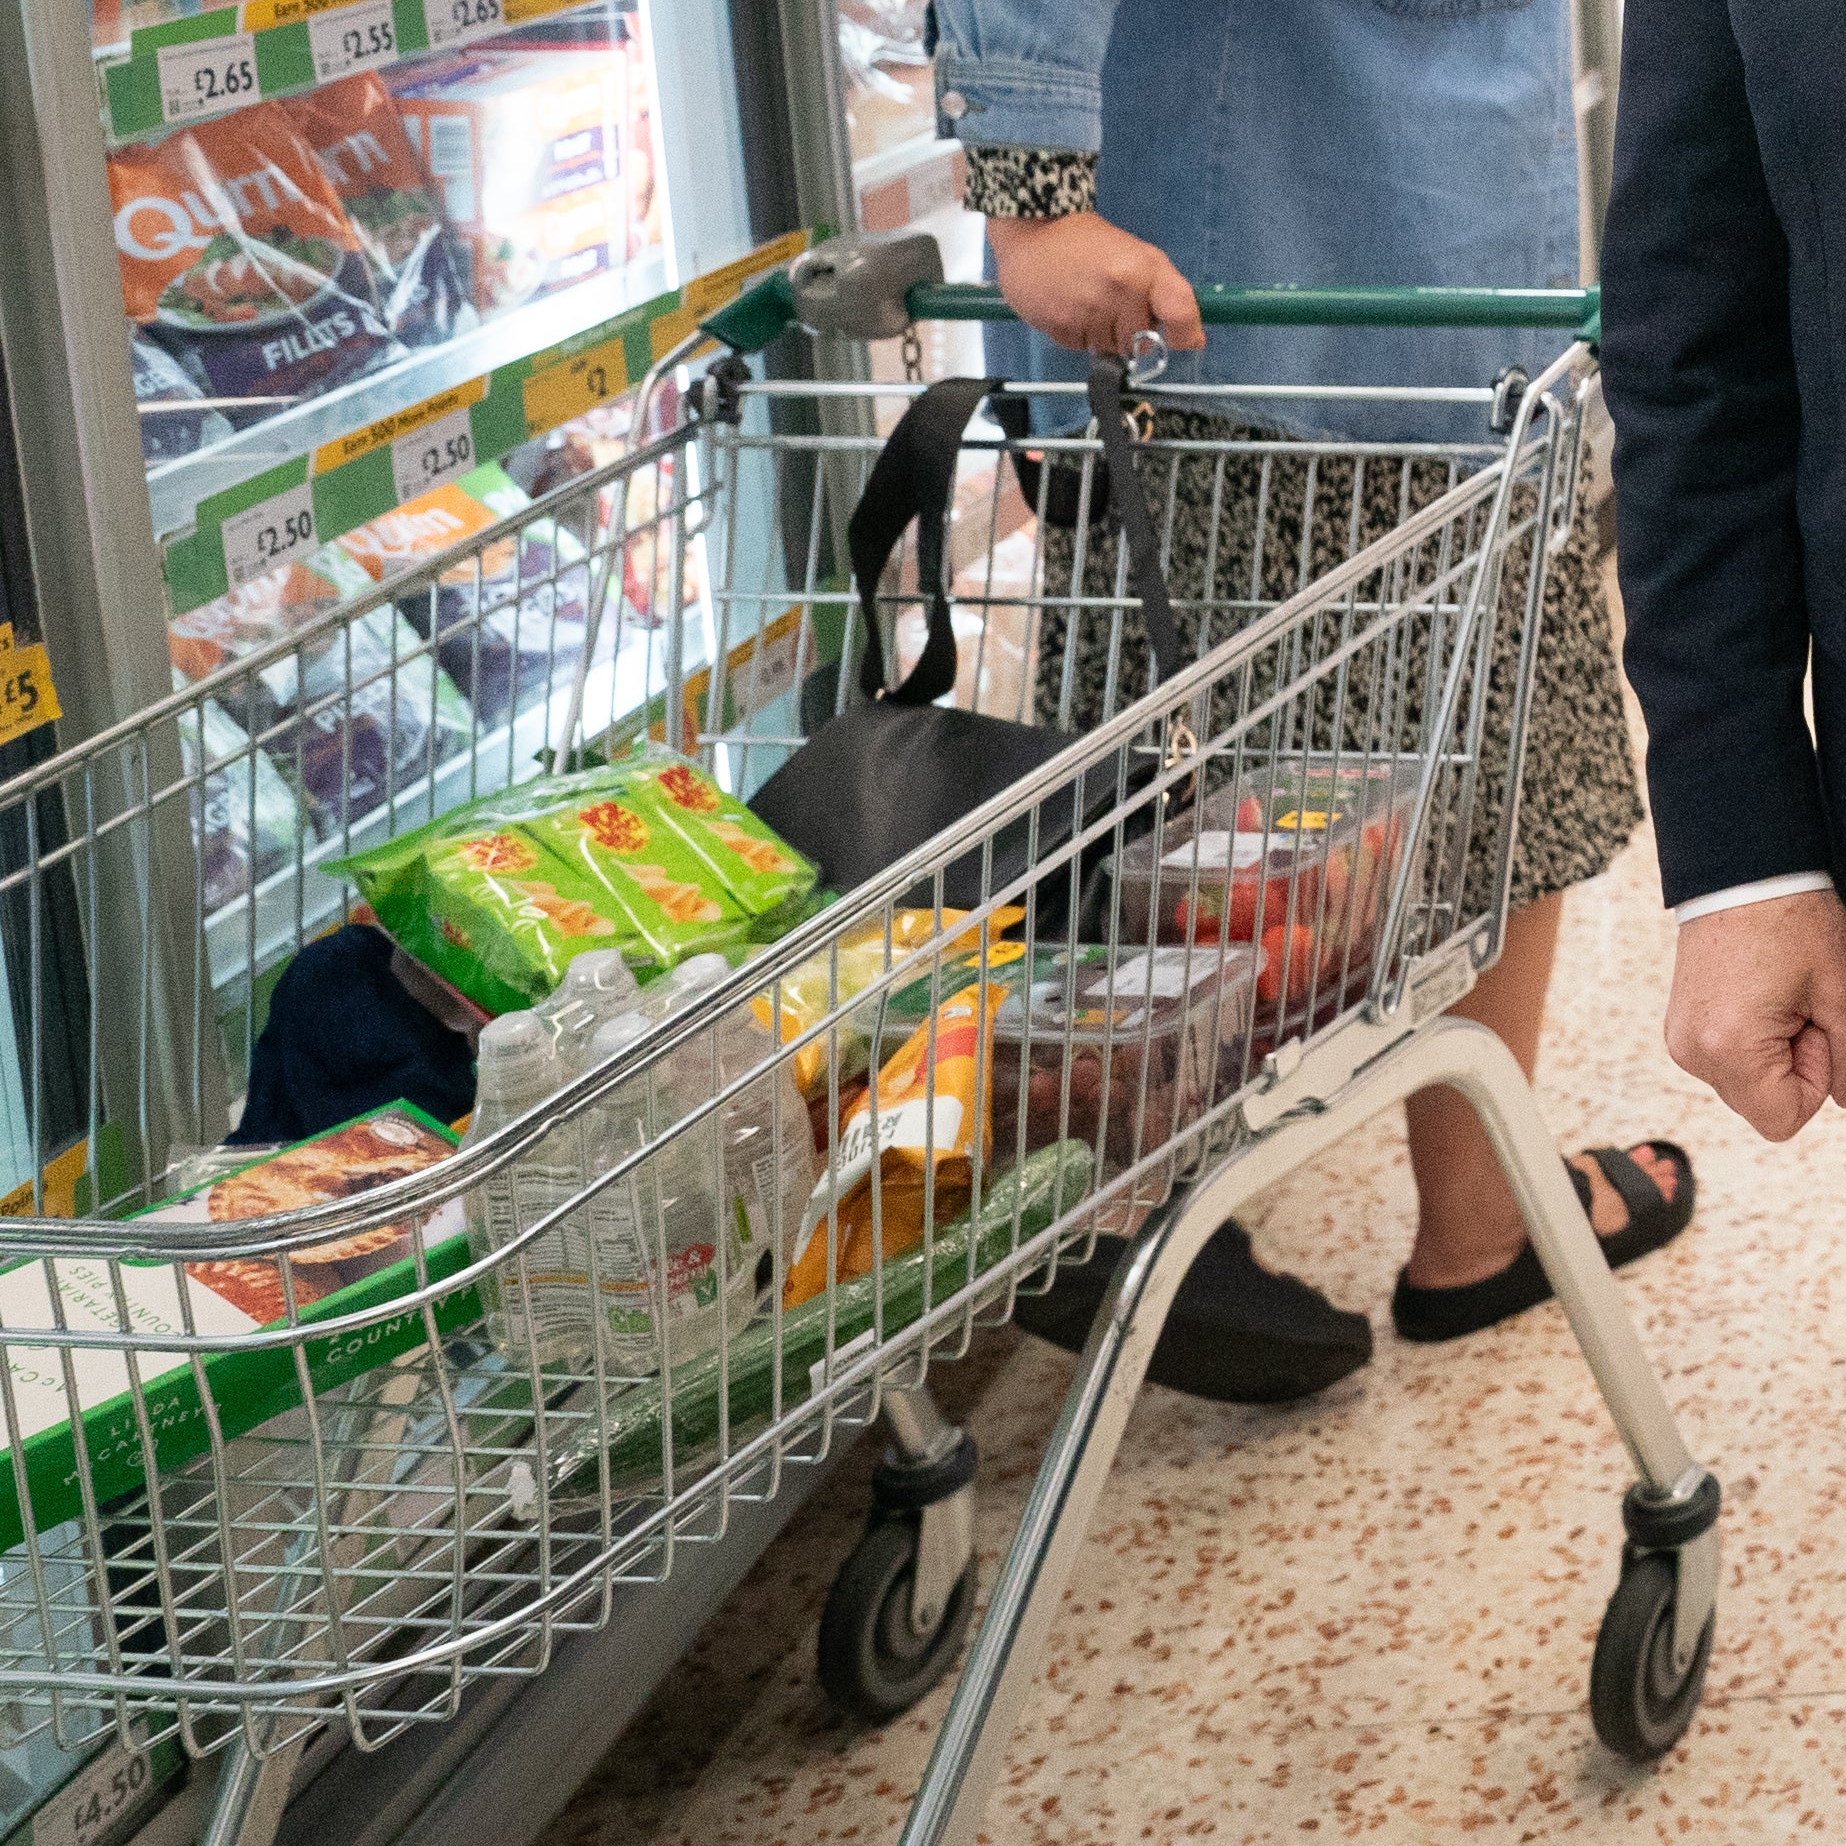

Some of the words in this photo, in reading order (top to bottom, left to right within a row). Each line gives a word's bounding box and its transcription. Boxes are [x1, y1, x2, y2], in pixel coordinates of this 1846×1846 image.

[343, 21, 394, 59] £2.55
[194, 61, 254, 99] £2.65
[420, 434, 470, 476] £2.50
[258, 509, 312, 558] £2.50
[5, 669, 39, 713] £5
[73, 1755, 147, 1832] £4.50
